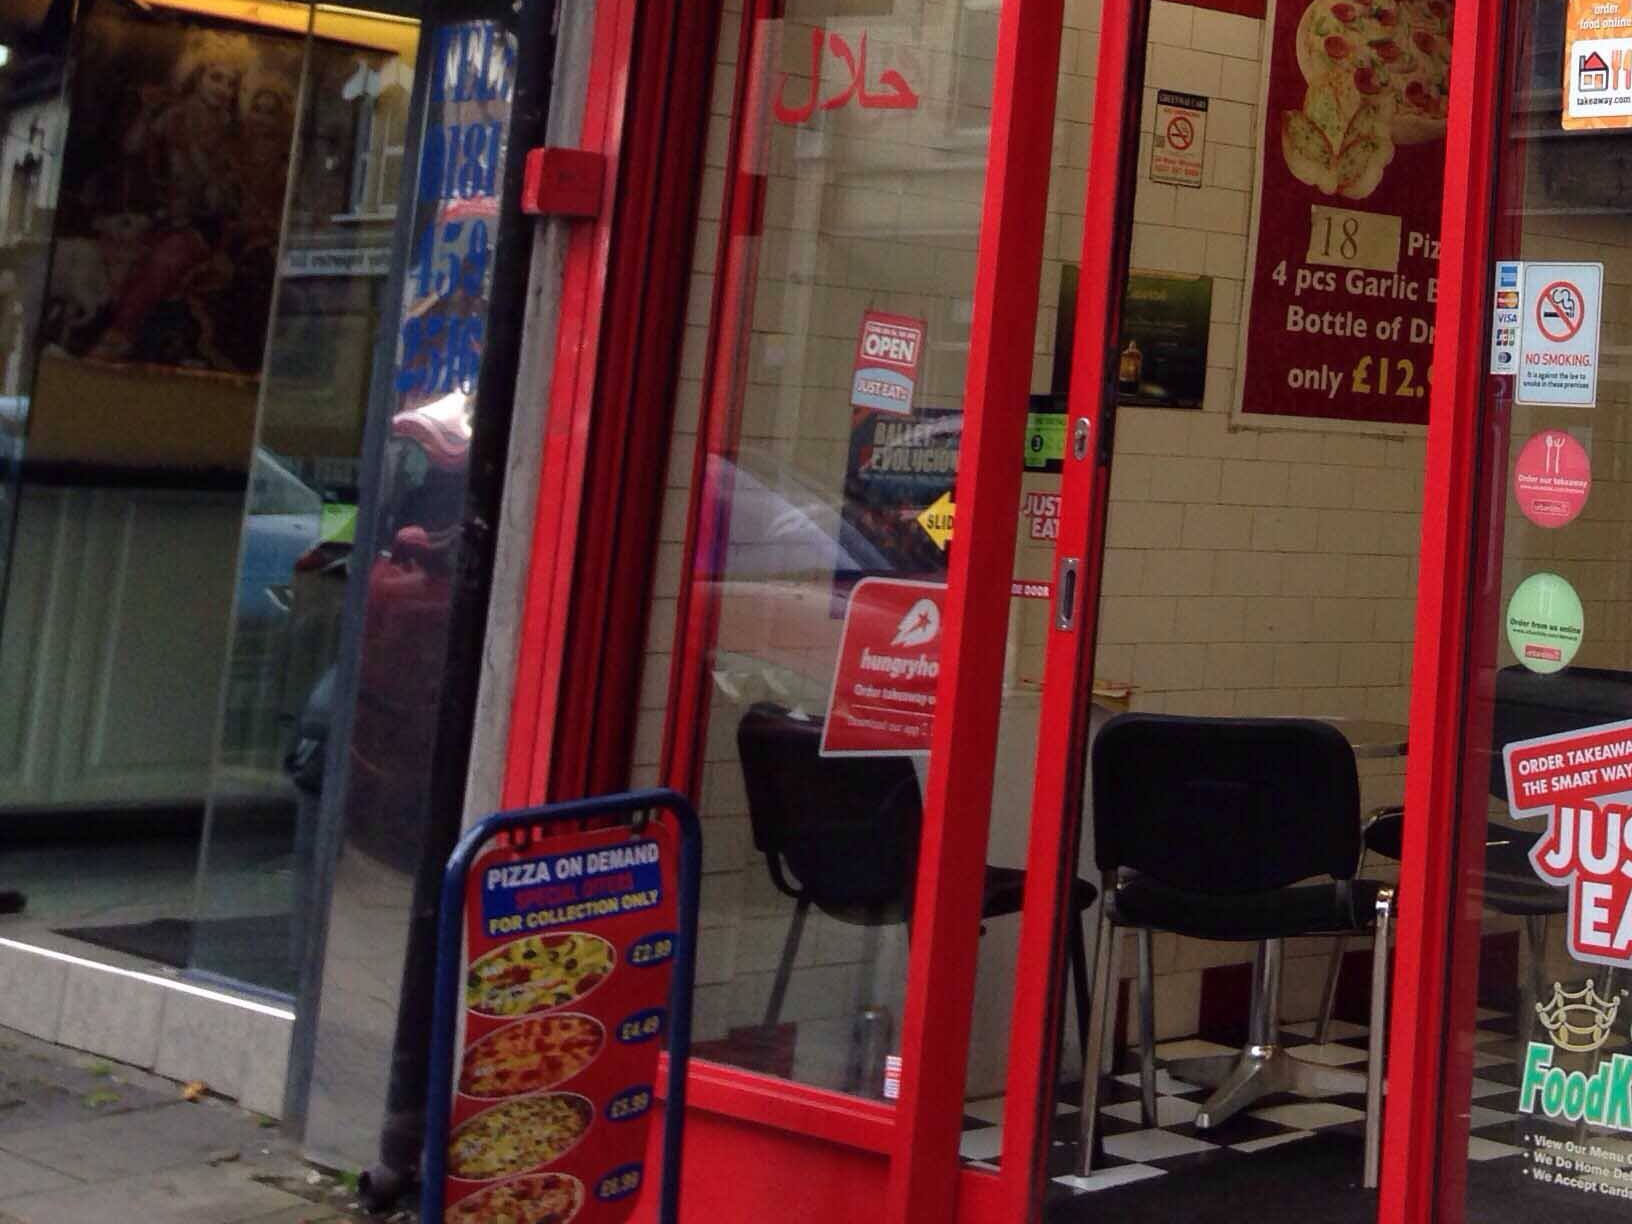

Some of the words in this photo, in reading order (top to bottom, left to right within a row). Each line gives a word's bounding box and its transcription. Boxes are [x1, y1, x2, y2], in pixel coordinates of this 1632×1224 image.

[771, 26, 919, 125] حلال
[1577, 96, 1632, 106] takeaway.com
[1320, 213, 1360, 260] 18
[1271, 260, 1288, 287] 4
[1294, 267, 1337, 297] pcs
[1344, 268, 1419, 302] Garlic
[1286, 304, 1368, 338] Bottle
[1375, 315, 1403, 342] of
[1497, 313, 1518, 323] VISA
[864, 333, 915, 362] OPEN
[1525, 353, 1540, 365] NO
[857, 380, 881, 394] JUST
[881, 383, 901, 398] EAT
[1287, 364, 1345, 399] only
[1351, 355, 1434, 398] £12.
[854, 684, 882, 698] Order
[1518, 752, 1564, 776] ORDER
[1522, 779, 1548, 797] THE
[1551, 768, 1598, 793] SMART
[487, 861, 551, 891] PIZZA
[554, 855, 584, 880] ON
[586, 842, 660, 875] DEMAND
[488, 914, 523, 936] FOR
[525, 896, 620, 928] COLLECTION
[620, 889, 660, 910] ONLY
[1534, 1134, 1563, 1151] View
[1565, 1140, 1587, 1154] Our
[1590, 1145, 1625, 1164] Menu
[1533, 1150, 1553, 1165] We
[1555, 1155, 1573, 1169] Do
[1574, 1160, 1610, 1178] Home
[1532, 1167, 1552, 1182] We
[1554, 1173, 1598, 1193] Accept
